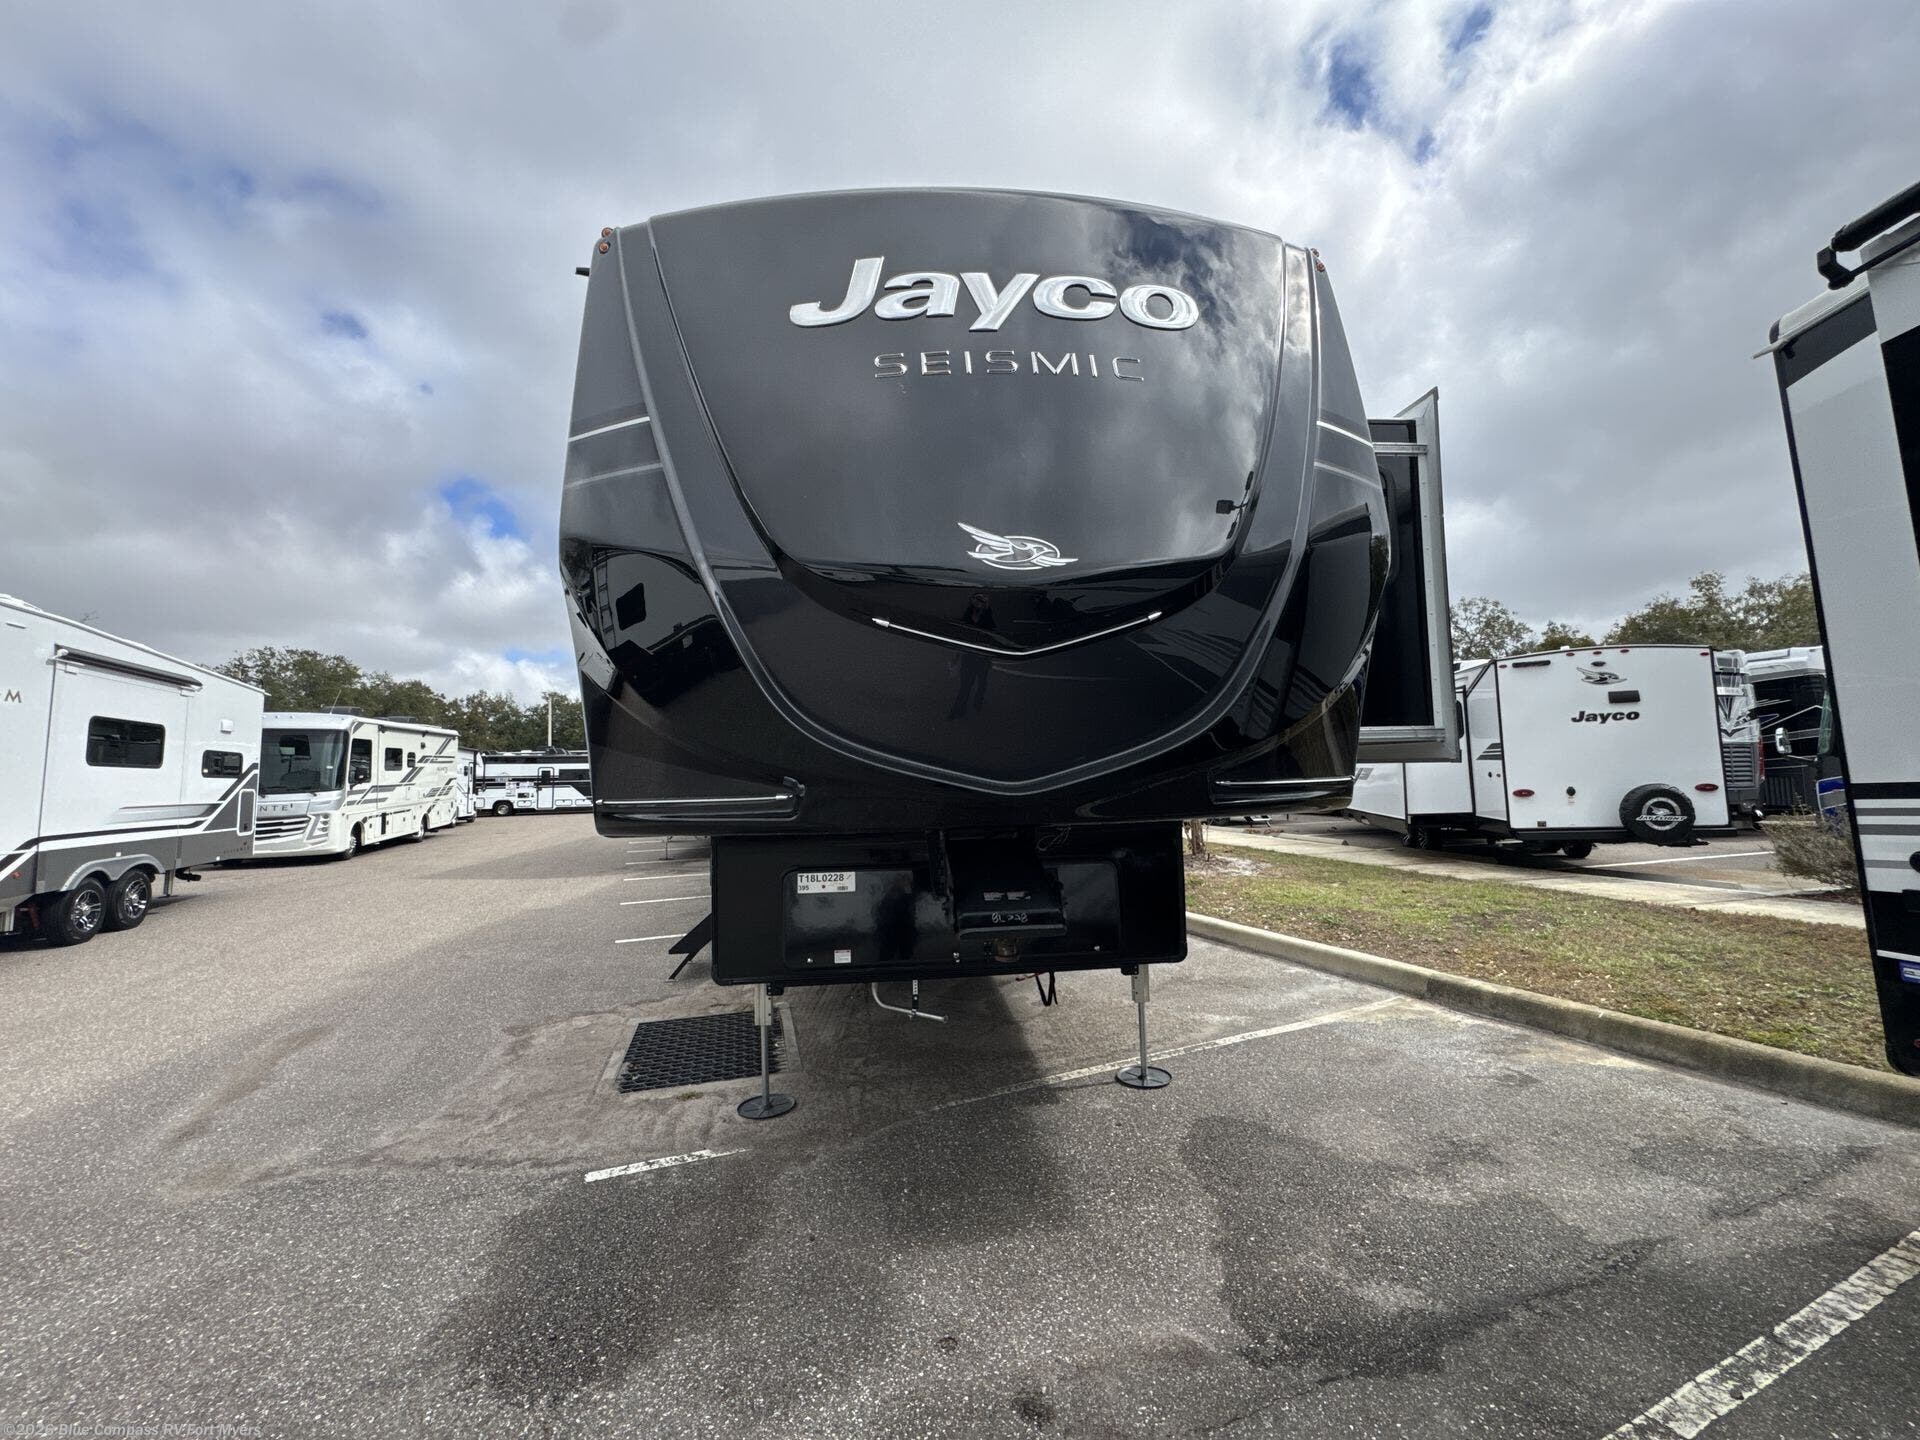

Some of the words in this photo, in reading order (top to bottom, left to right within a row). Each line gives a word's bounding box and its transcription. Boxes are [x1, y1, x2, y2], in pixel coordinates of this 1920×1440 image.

[789, 255, 1200, 333] Jayco
[873, 349, 1145, 383] SEISMIC
[1571, 710, 1640, 725] Jayco
[799, 874, 844, 883] T18L0228
